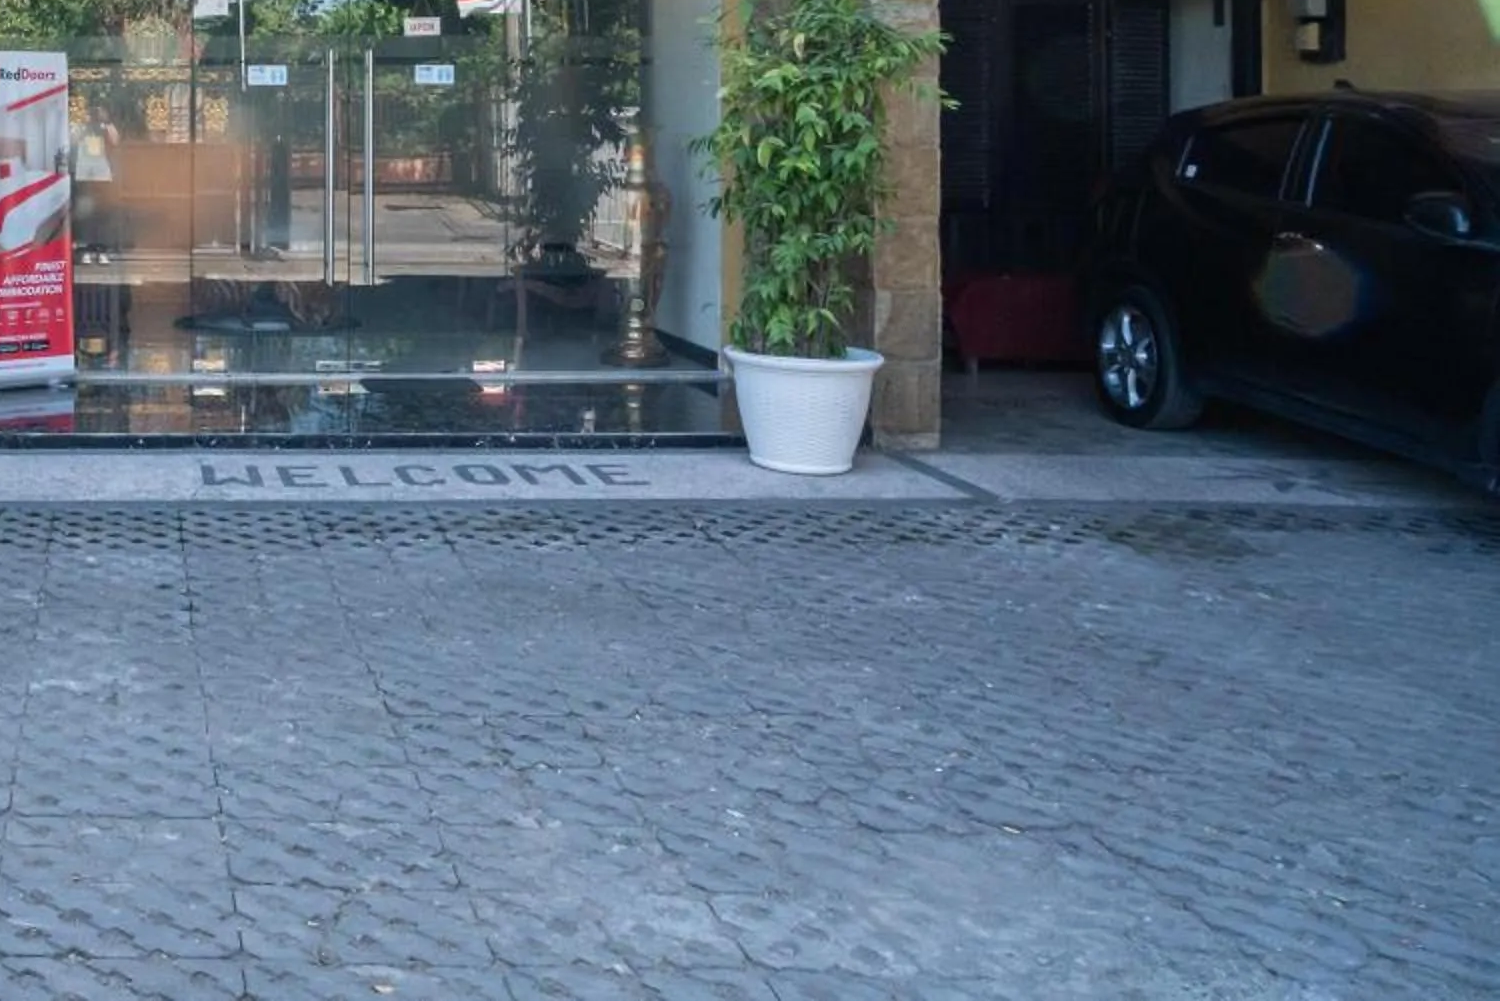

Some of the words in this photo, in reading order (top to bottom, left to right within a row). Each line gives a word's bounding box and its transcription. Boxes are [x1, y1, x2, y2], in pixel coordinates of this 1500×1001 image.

[0, 67, 55, 81] RedDoorz
[3, 272, 65, 285] AFFORDABLE
[200, 464, 650, 487] WELCOME
